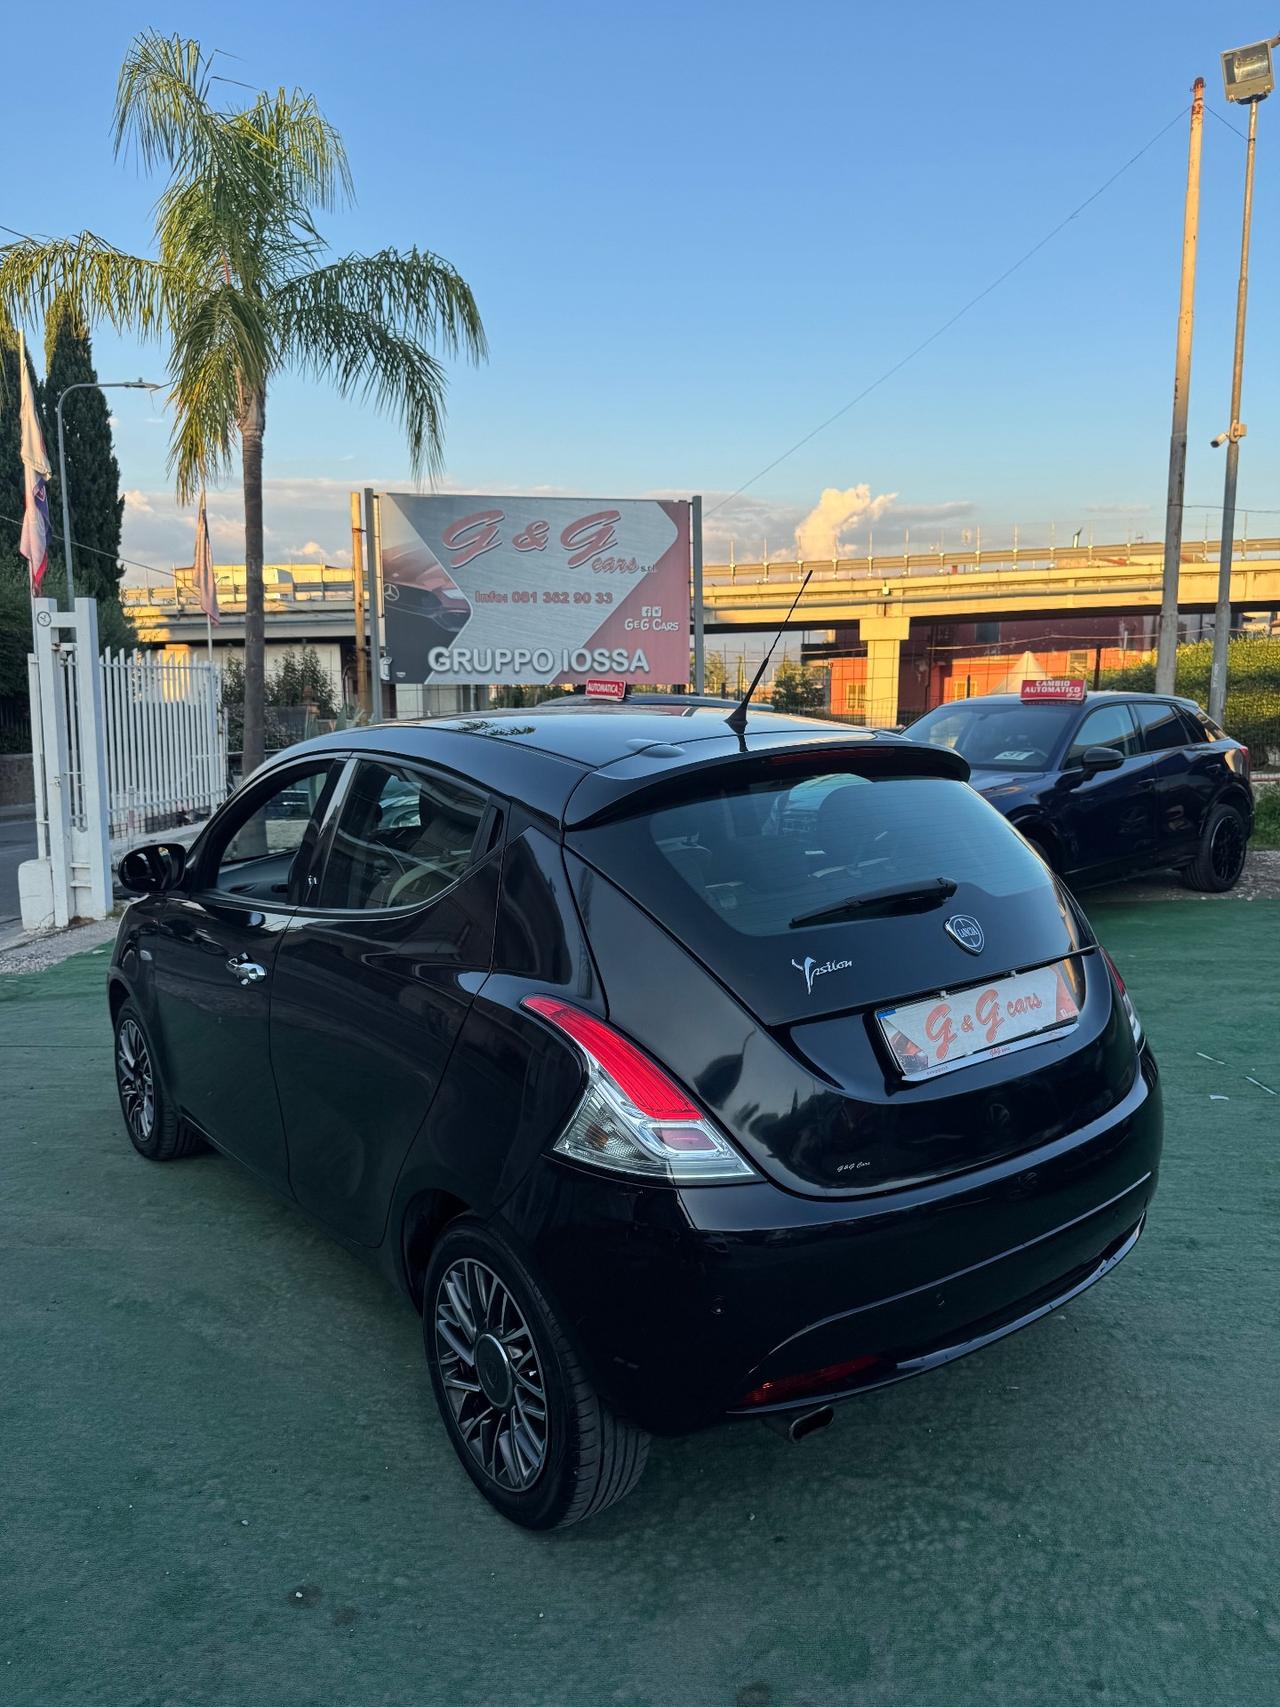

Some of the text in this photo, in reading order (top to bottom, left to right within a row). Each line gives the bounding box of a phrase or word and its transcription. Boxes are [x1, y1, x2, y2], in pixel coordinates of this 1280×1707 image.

[442, 510, 621, 568] G & G
[592, 557, 639, 574] cars
[475, 590, 508, 604] Info:
[595, 592, 613, 605] 33
[427, 645, 650, 673] GRUPPO IOSSA
[791, 956, 853, 995] Ypsilon
[961, 1014, 974, 1032] &
[1006, 993, 1043, 1018] cars
